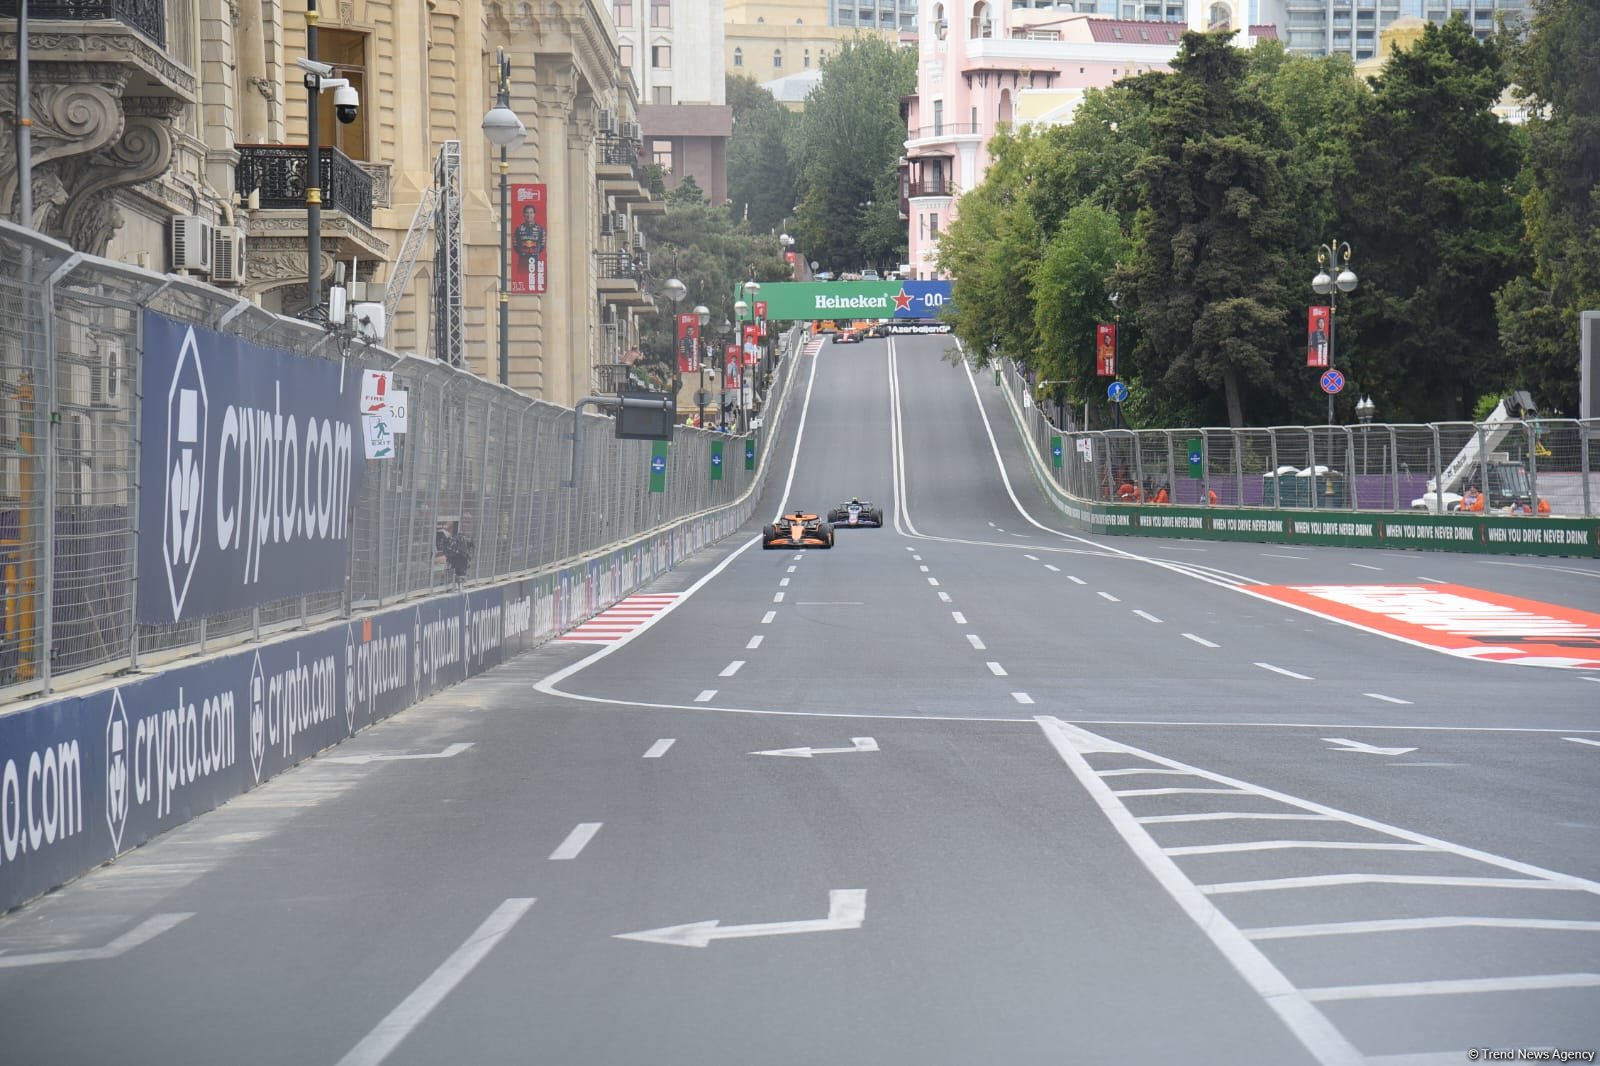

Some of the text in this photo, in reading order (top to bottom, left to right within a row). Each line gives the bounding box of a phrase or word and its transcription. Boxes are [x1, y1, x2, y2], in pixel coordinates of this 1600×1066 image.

[815, 294, 887, 308] Heineken
[924, 293, 942, 306] 0.0
[217, 380, 352, 584] crypto.com
[1213, 518, 1283, 532] WHEN YOU DRIVE NEVER DRINK
[1295, 522, 1372, 536] WHEN YOU DRIVE NEVER DRINK
[1386, 525, 1473, 540] WHEN YOU DRIVE NEVER DRINK
[1488, 528, 1588, 544] WHEN YOU DRIVE NEVER DRINK
[357, 624, 406, 714] crypto.com
[422, 608, 460, 685] crypto.com
[268, 651, 336, 758] crypto.com
[135, 686, 235, 819] crypto.com
[0, 739, 82, 865] o.com
